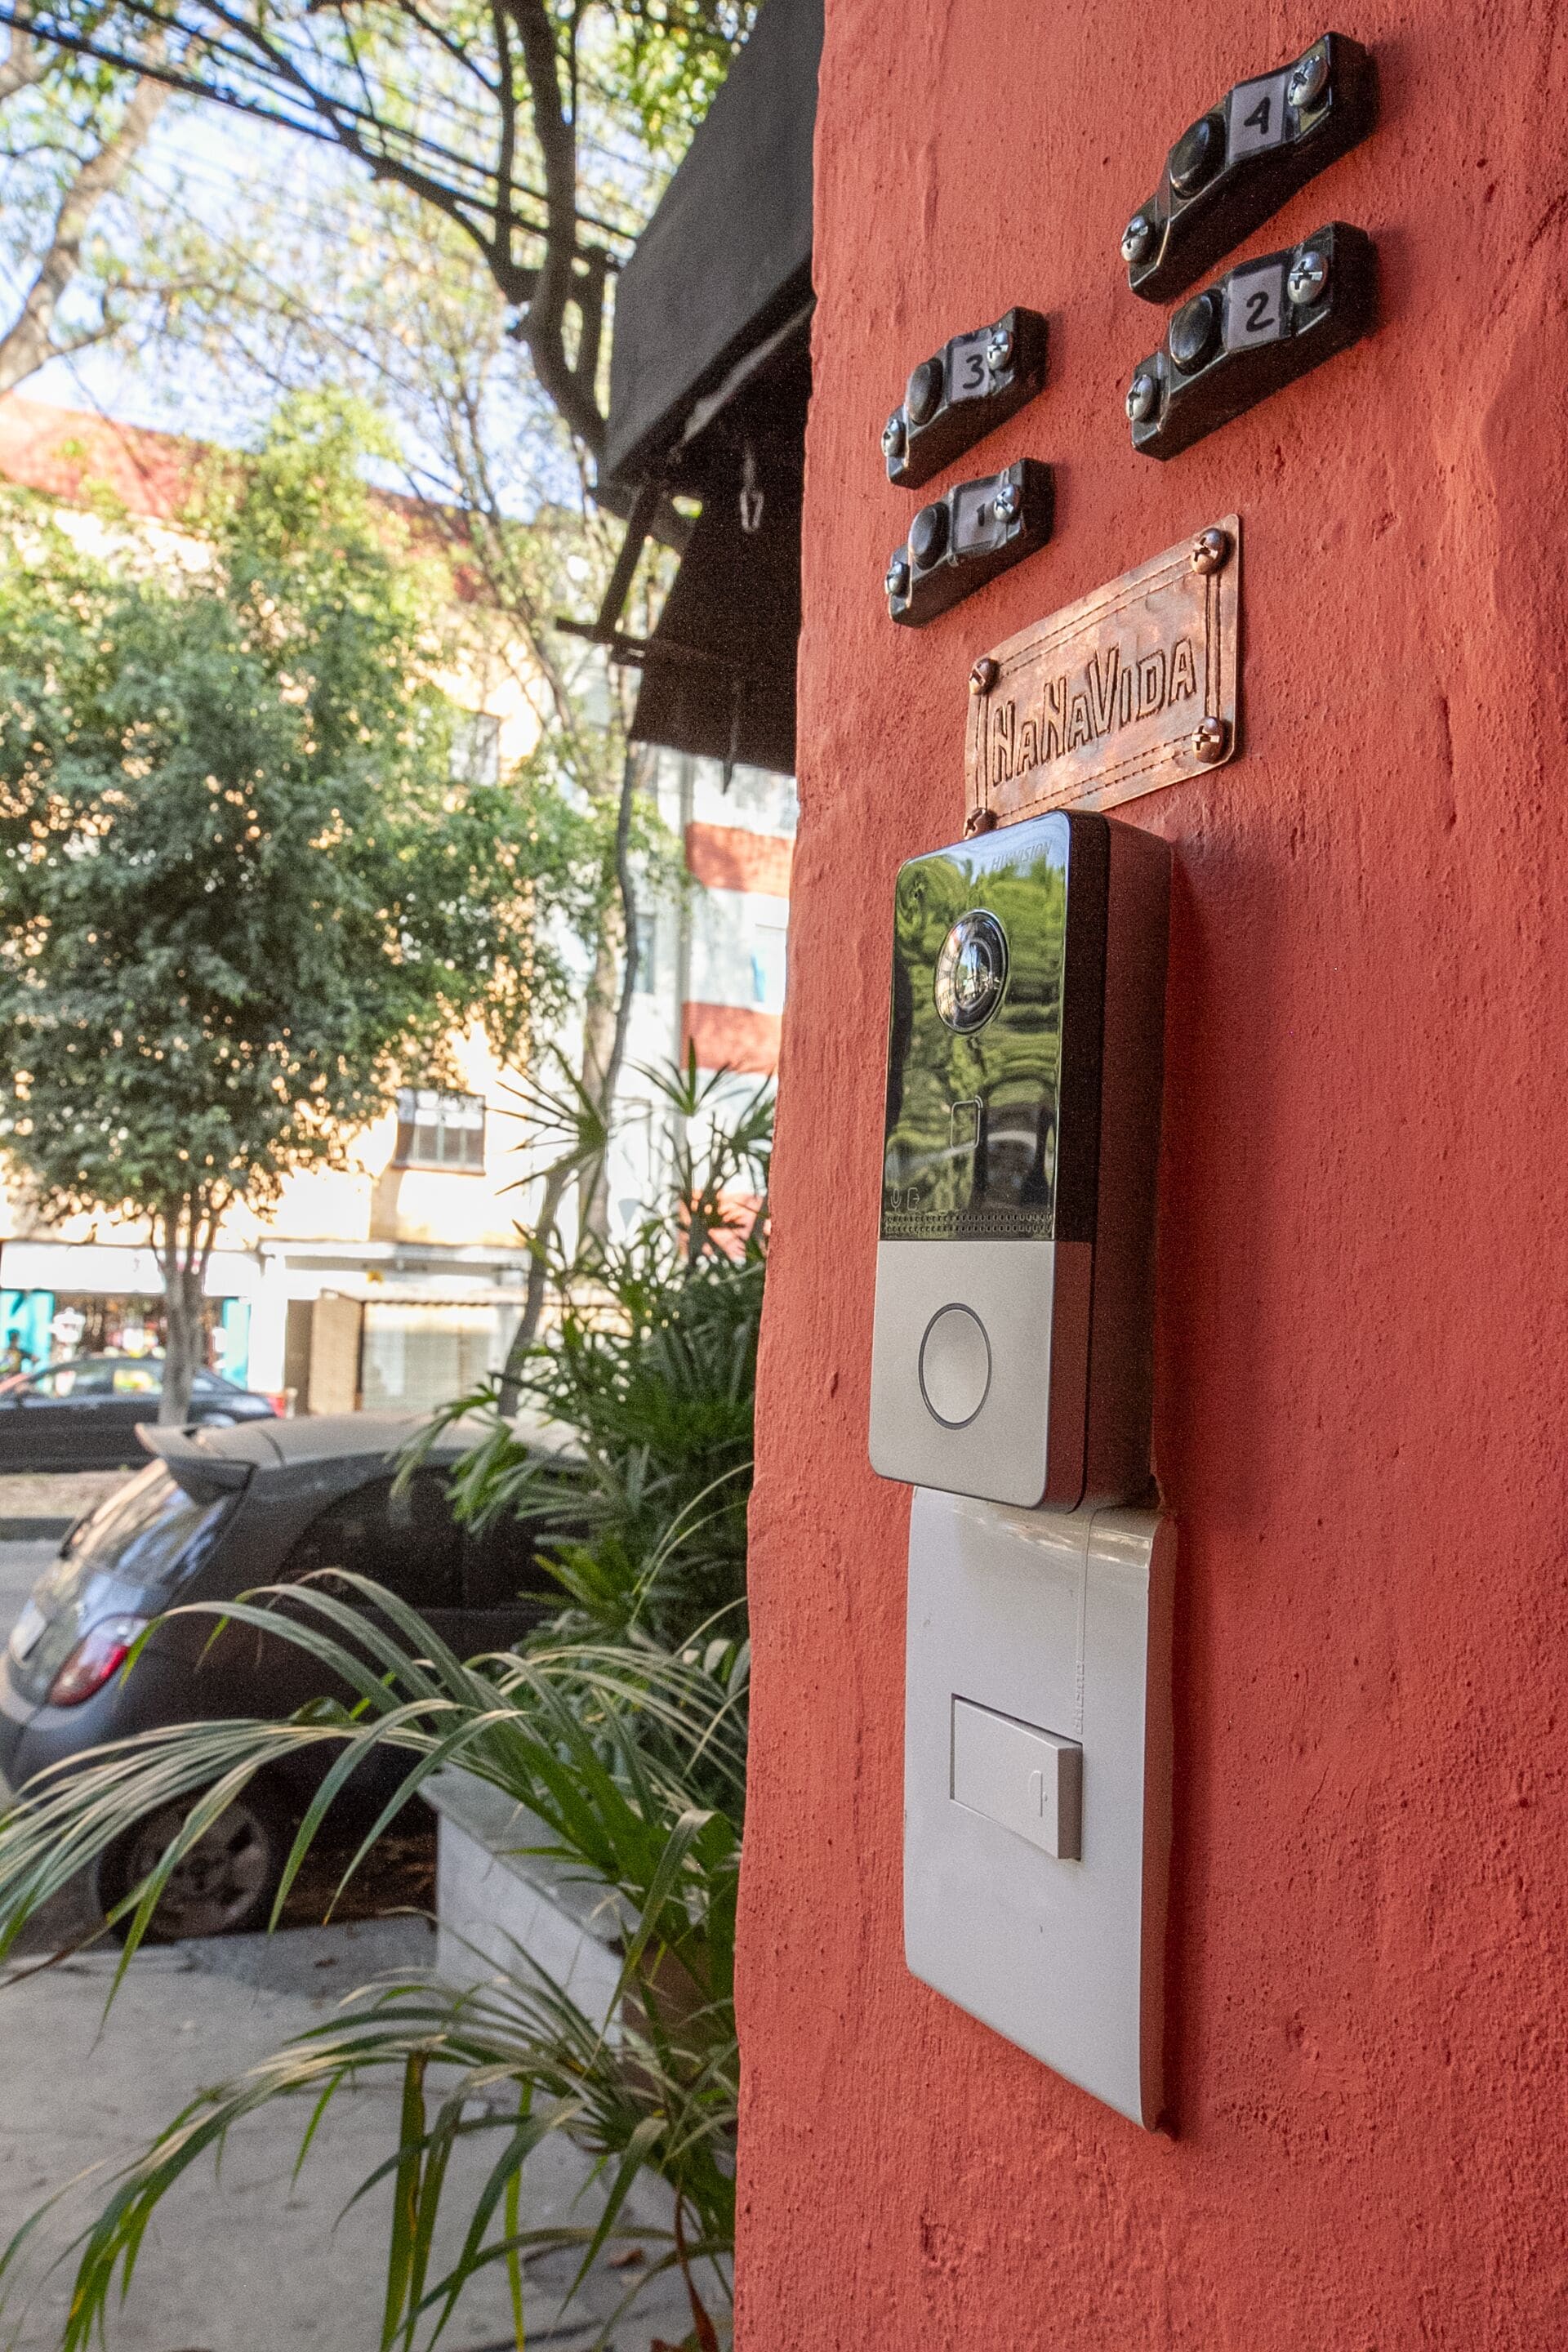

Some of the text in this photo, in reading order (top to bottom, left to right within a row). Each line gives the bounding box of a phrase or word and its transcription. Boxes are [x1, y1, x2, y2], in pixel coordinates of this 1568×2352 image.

[1244, 96, 1271, 135] 4
[1245, 290, 1275, 332] 2
[962, 354, 985, 390] 3
[976, 503, 986, 527] 1
